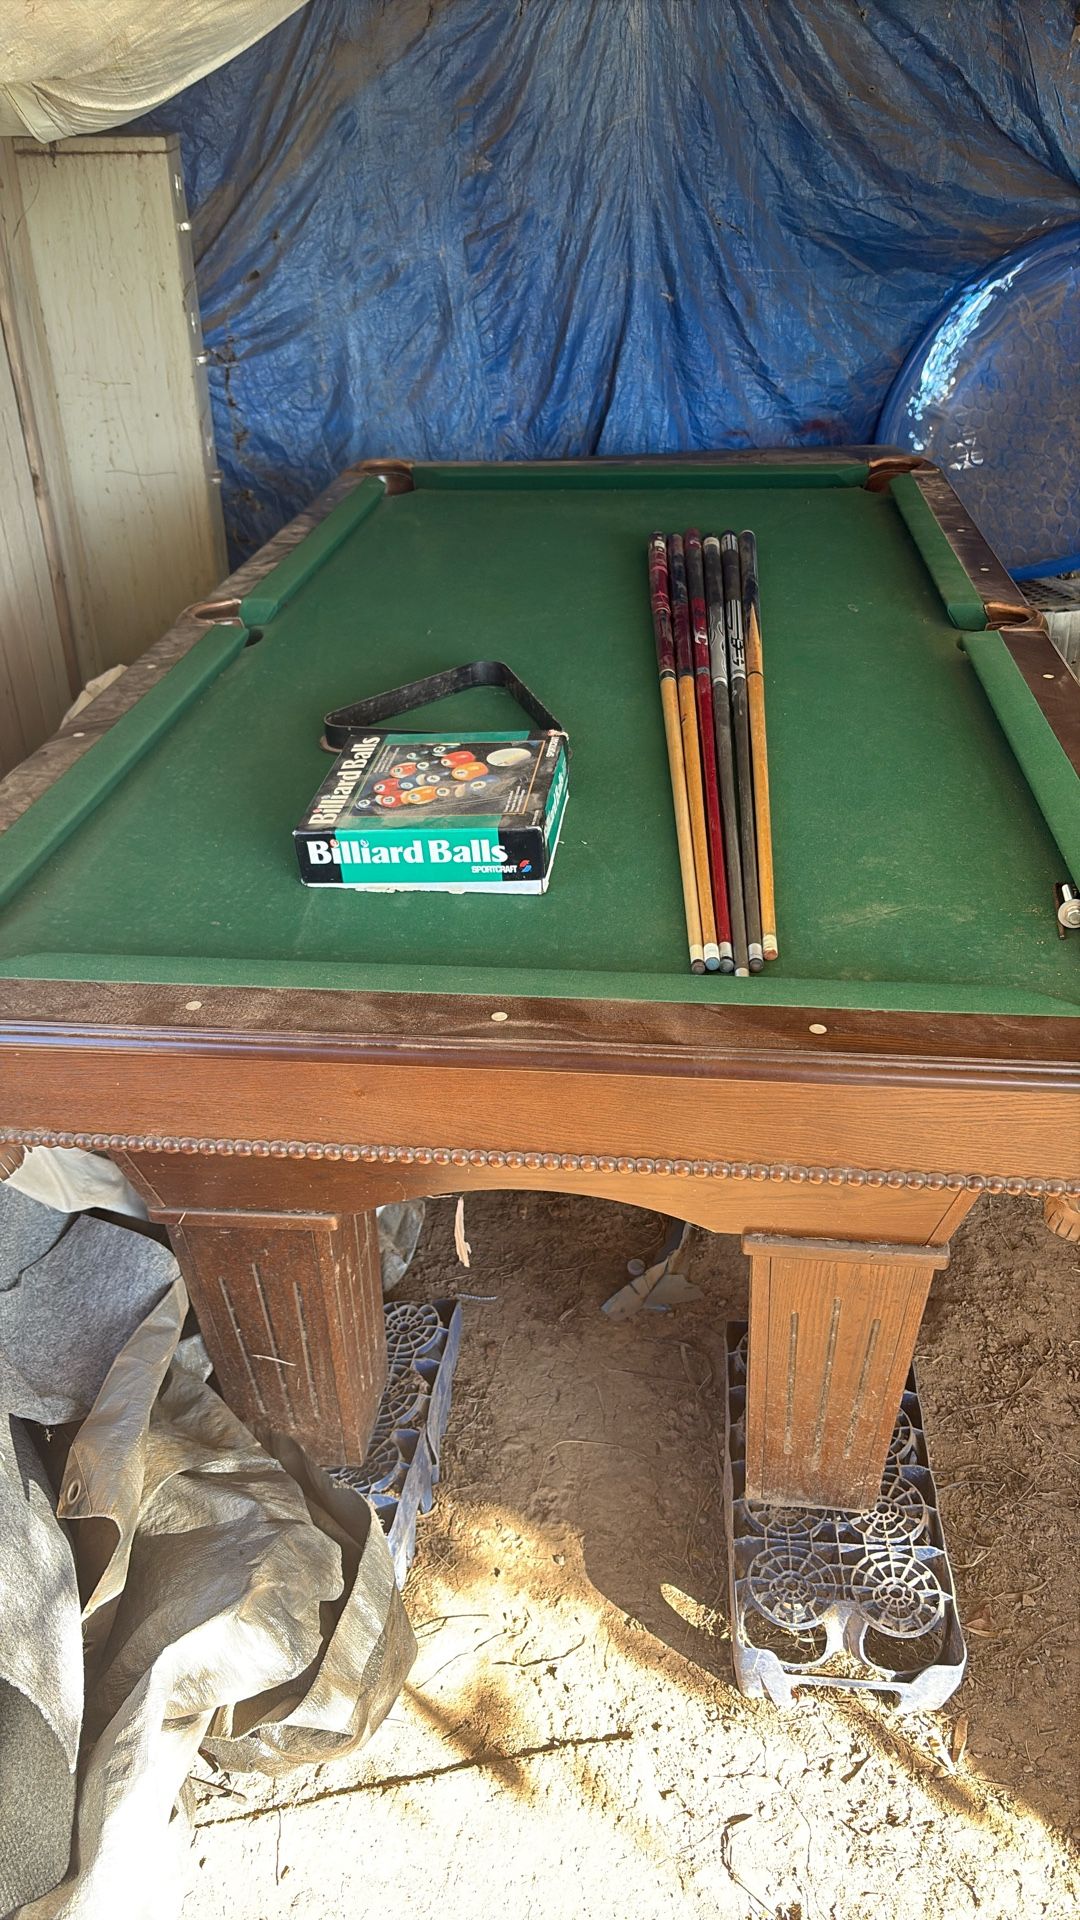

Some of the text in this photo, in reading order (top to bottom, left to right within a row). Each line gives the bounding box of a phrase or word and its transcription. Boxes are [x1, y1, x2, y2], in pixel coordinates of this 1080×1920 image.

[308, 737, 380, 824] Billiard Balls
[306, 839, 509, 864] Billiard Balls
[471, 865, 517, 873] SPORTCRAFT
